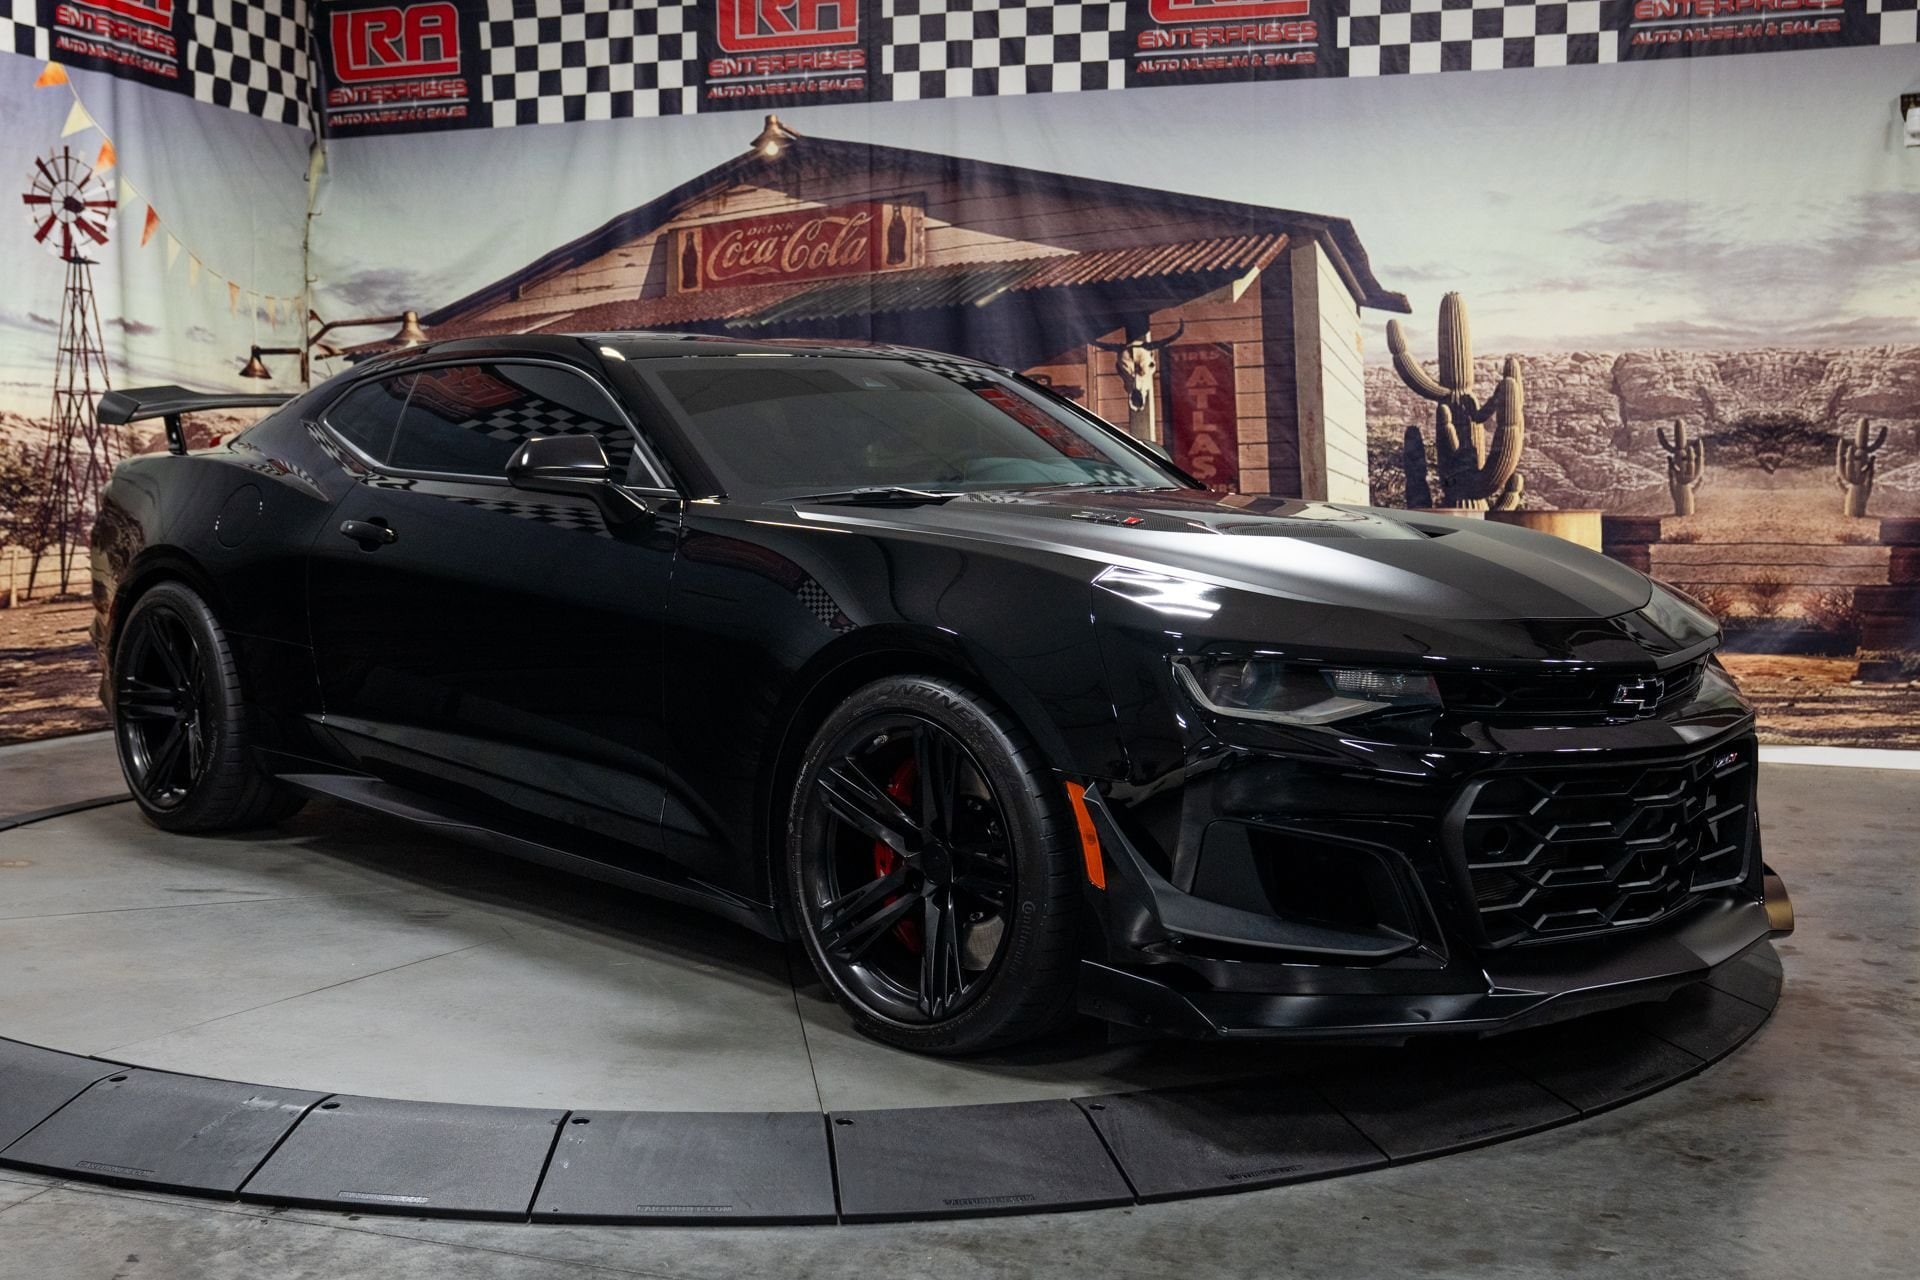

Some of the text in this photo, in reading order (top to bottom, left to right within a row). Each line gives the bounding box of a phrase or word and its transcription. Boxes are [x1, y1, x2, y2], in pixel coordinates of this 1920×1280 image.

[55, 4, 177, 56] ENTERPRISES
[1137, 21, 1318, 48] ENTERPRISES
[1632, 18, 1841, 45] AUTO MUSEUM & SALES
[708, 49, 866, 76] ENTERPRISES
[1136, 51, 1317, 73] AUTO MUSEUM & SALES
[328, 78, 468, 106] ENTERPRISES
[707, 85, 746, 99] AUTO
[819, 77, 865, 91] SALES
[328, 112, 362, 127] AUTO
[746, 222, 795, 236] DRINK
[706, 211, 875, 281] Coca-Cola
[1185, 365, 1222, 480] ATLAS
